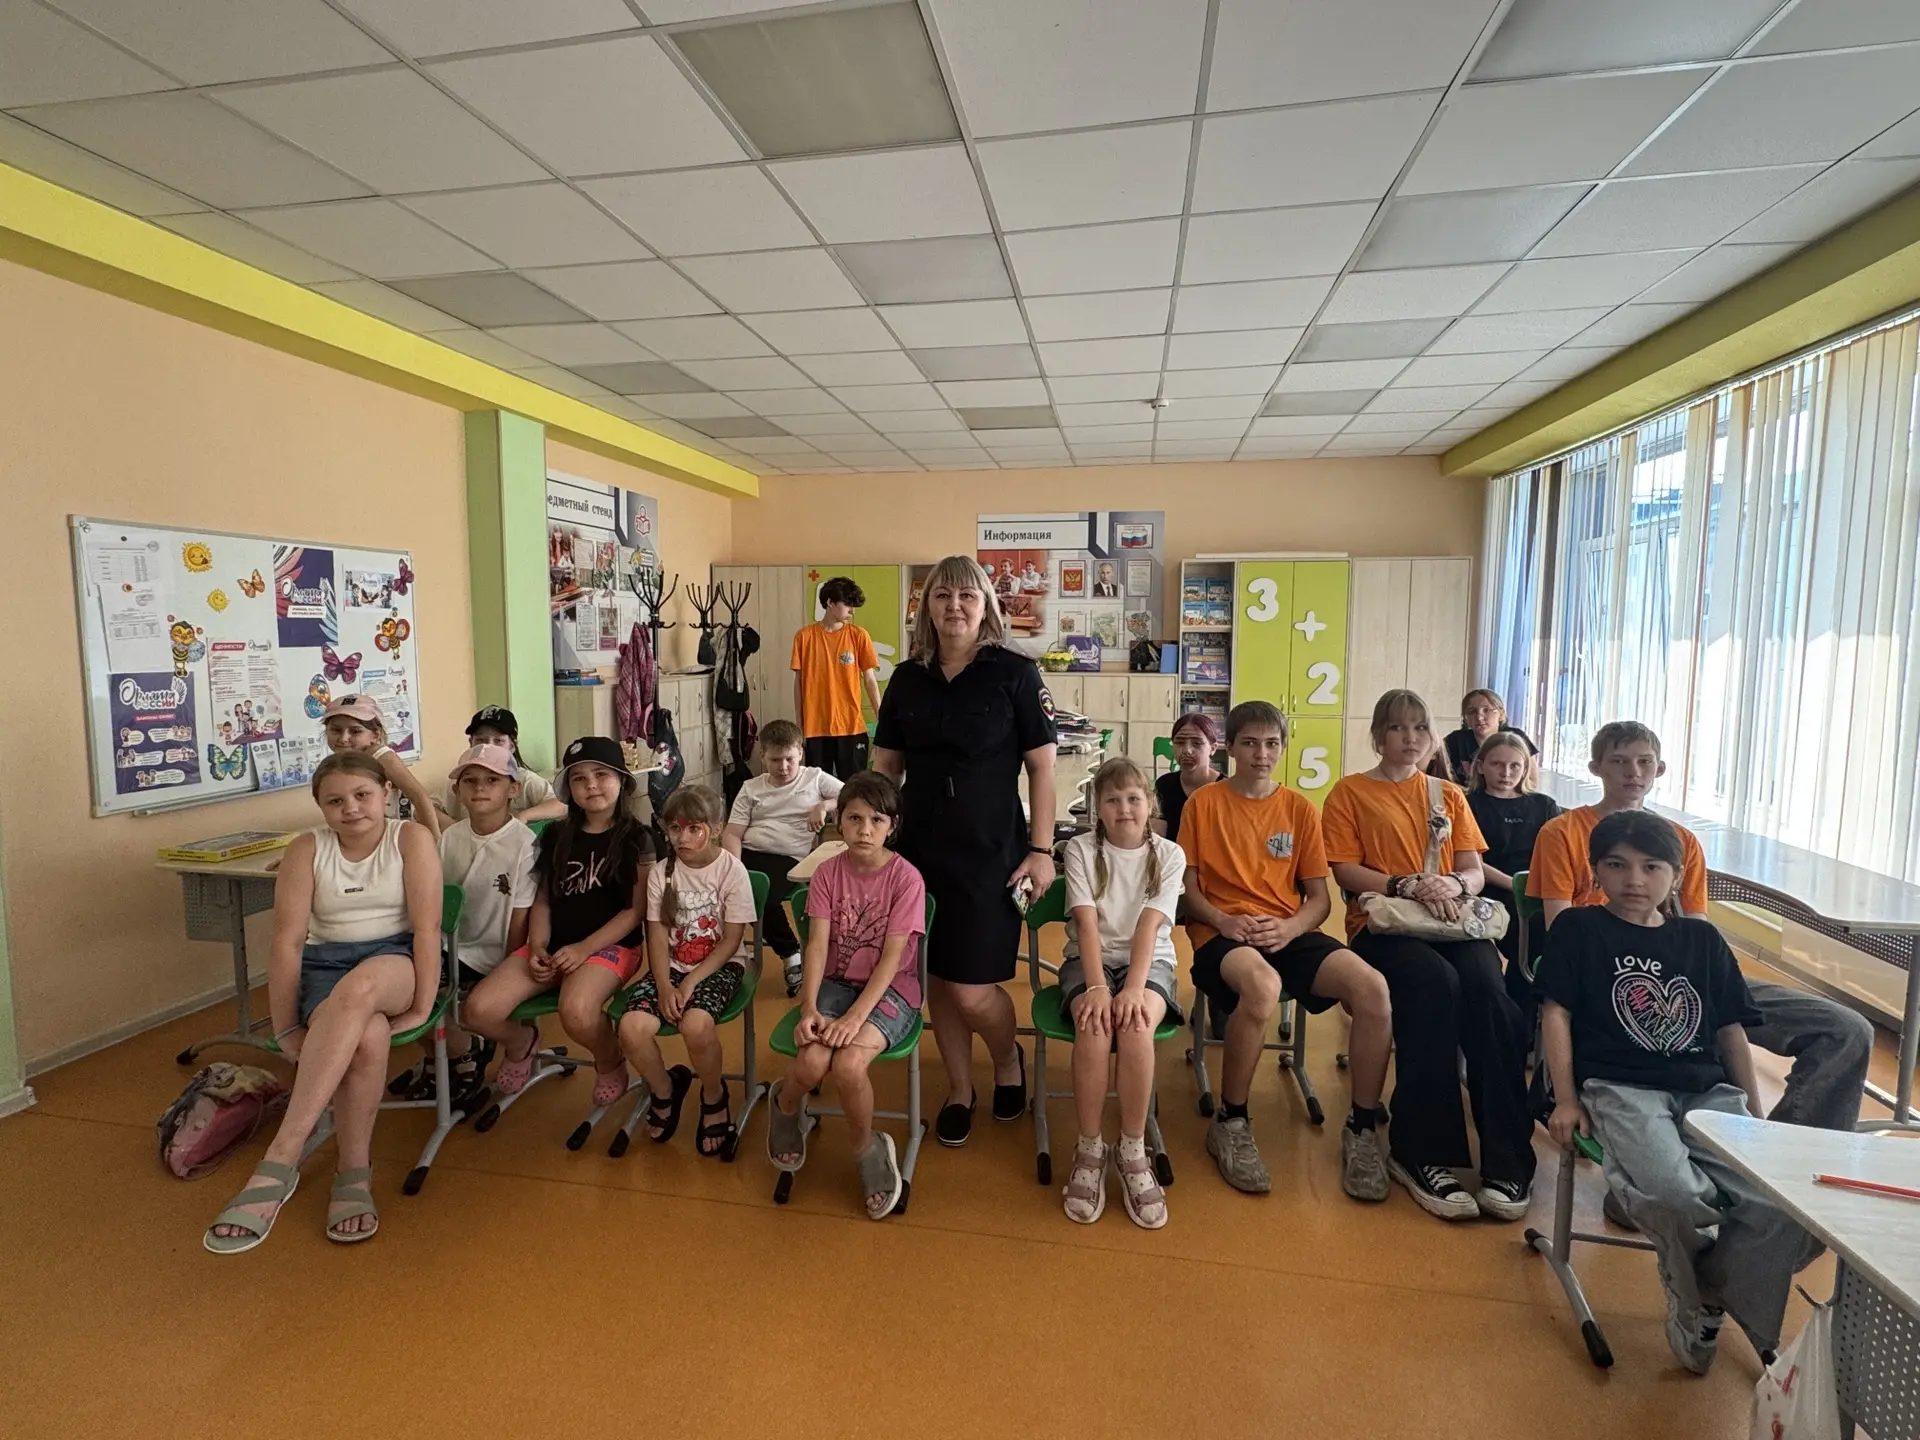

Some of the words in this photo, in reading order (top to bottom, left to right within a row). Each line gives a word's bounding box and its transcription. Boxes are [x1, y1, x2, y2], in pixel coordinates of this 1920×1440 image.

[546, 494, 589, 513] едметный
[591, 504, 613, 520] стенд
[983, 529, 1052, 543] Информация
[1247, 577, 1279, 622] 3
[120, 679, 176, 707] Орлята
[1306, 661, 1340, 705] 2
[1298, 746, 1331, 790] 5
